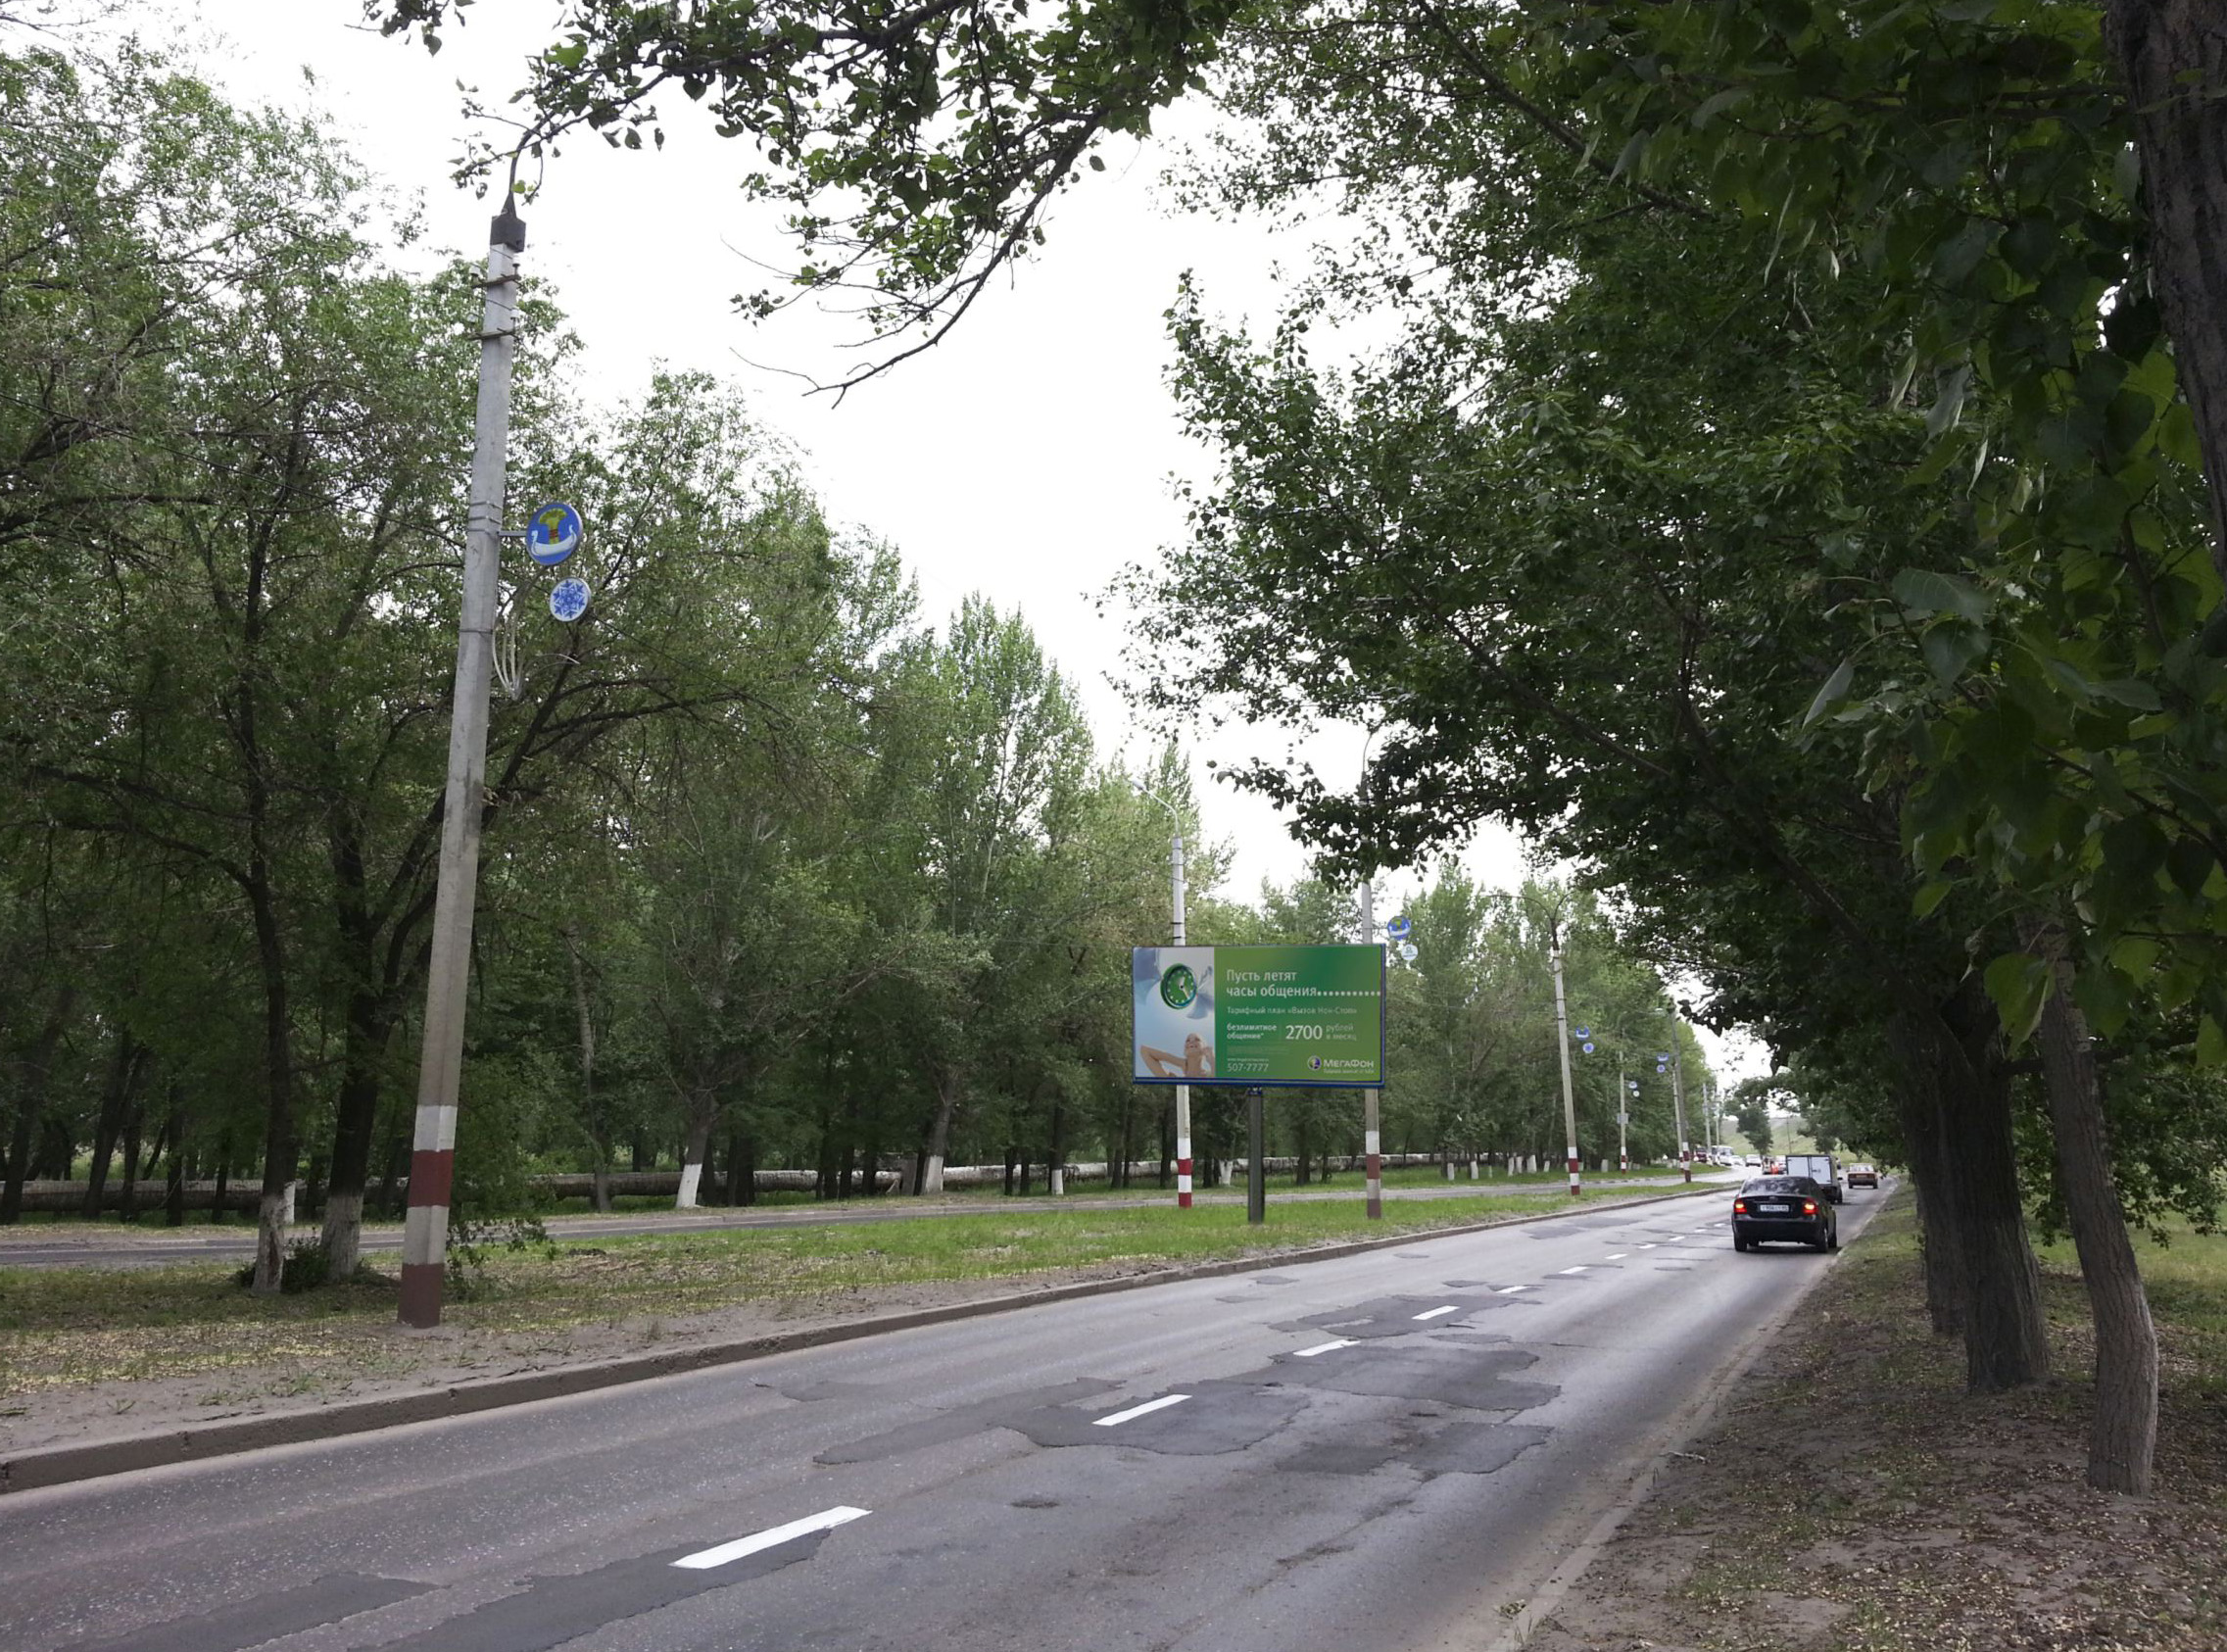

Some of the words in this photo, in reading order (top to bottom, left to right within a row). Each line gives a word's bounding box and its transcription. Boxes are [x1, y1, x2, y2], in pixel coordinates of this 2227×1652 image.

[1226, 969, 1261, 985] Пусть
[1264, 971, 1297, 982] летят
[1226, 987, 1257, 997] часы
[1227, 1005, 1266, 1015] Тарифный
[1227, 1022, 1278, 1032] безлимитное
[1326, 1024, 1354, 1034] рублей
[1284, 1025, 1323, 1041] 2700
